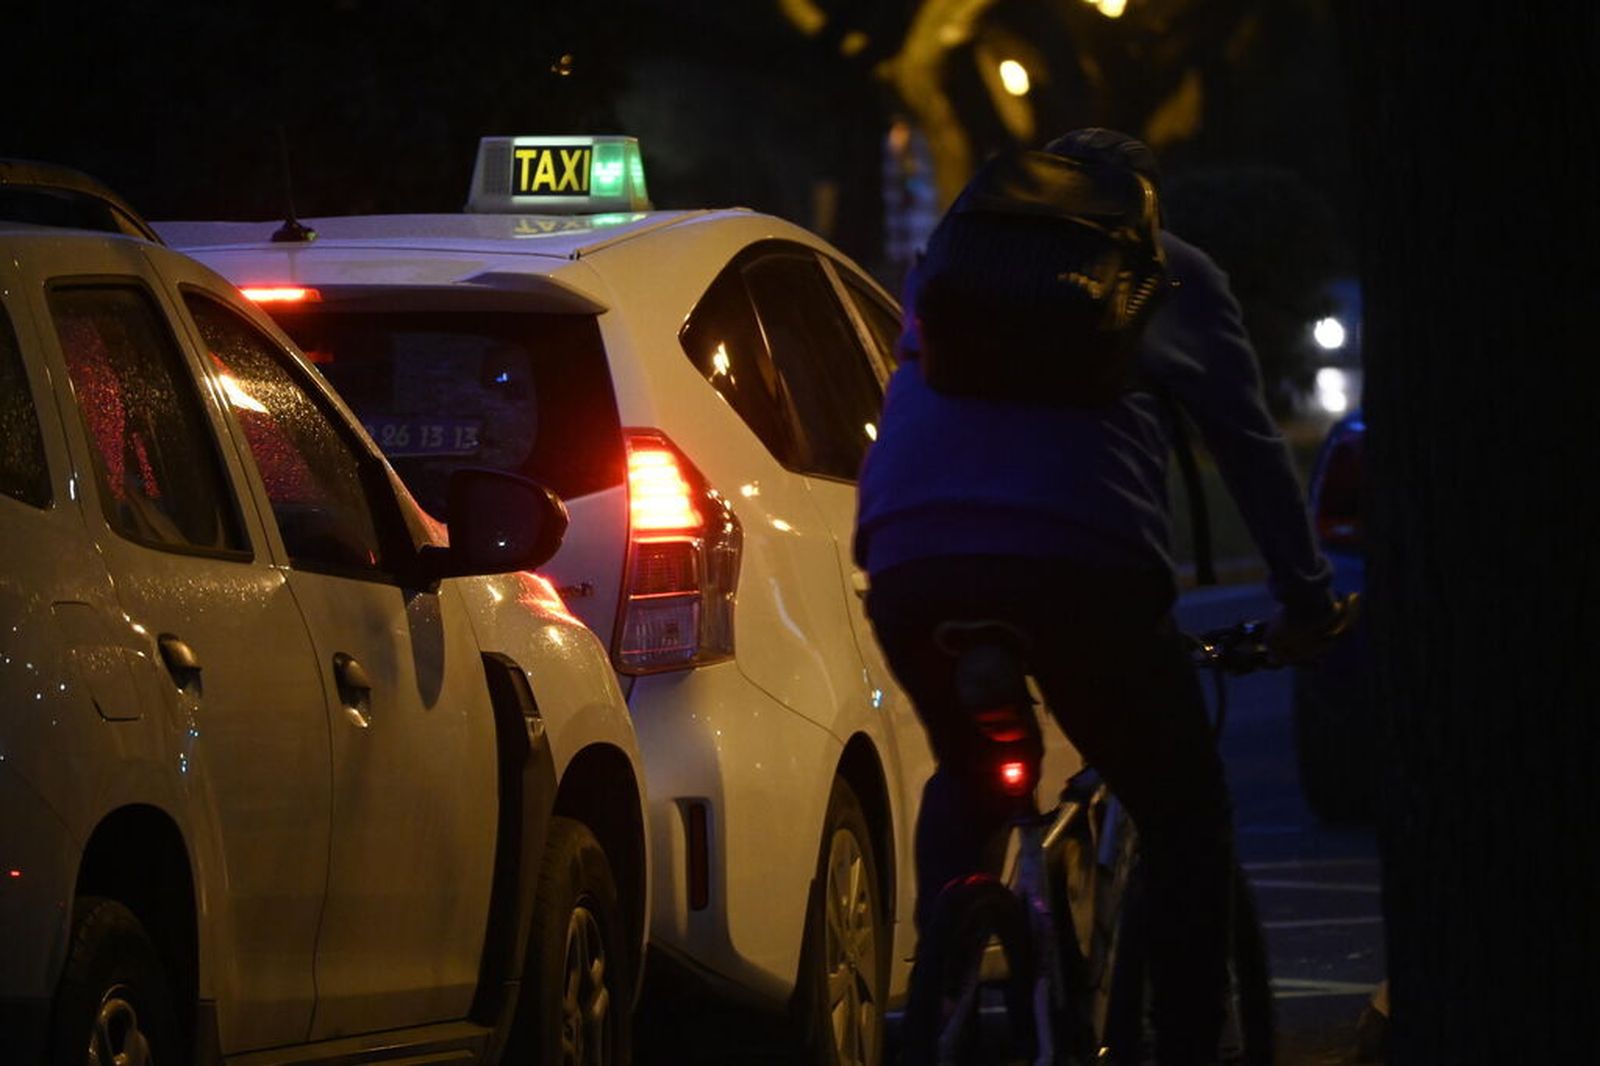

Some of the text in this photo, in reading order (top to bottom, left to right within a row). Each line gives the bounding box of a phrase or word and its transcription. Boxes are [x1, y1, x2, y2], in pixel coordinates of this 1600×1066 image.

[515, 149, 590, 192] TAXI
[420, 425, 444, 448] 13
[454, 425, 478, 449] 13
